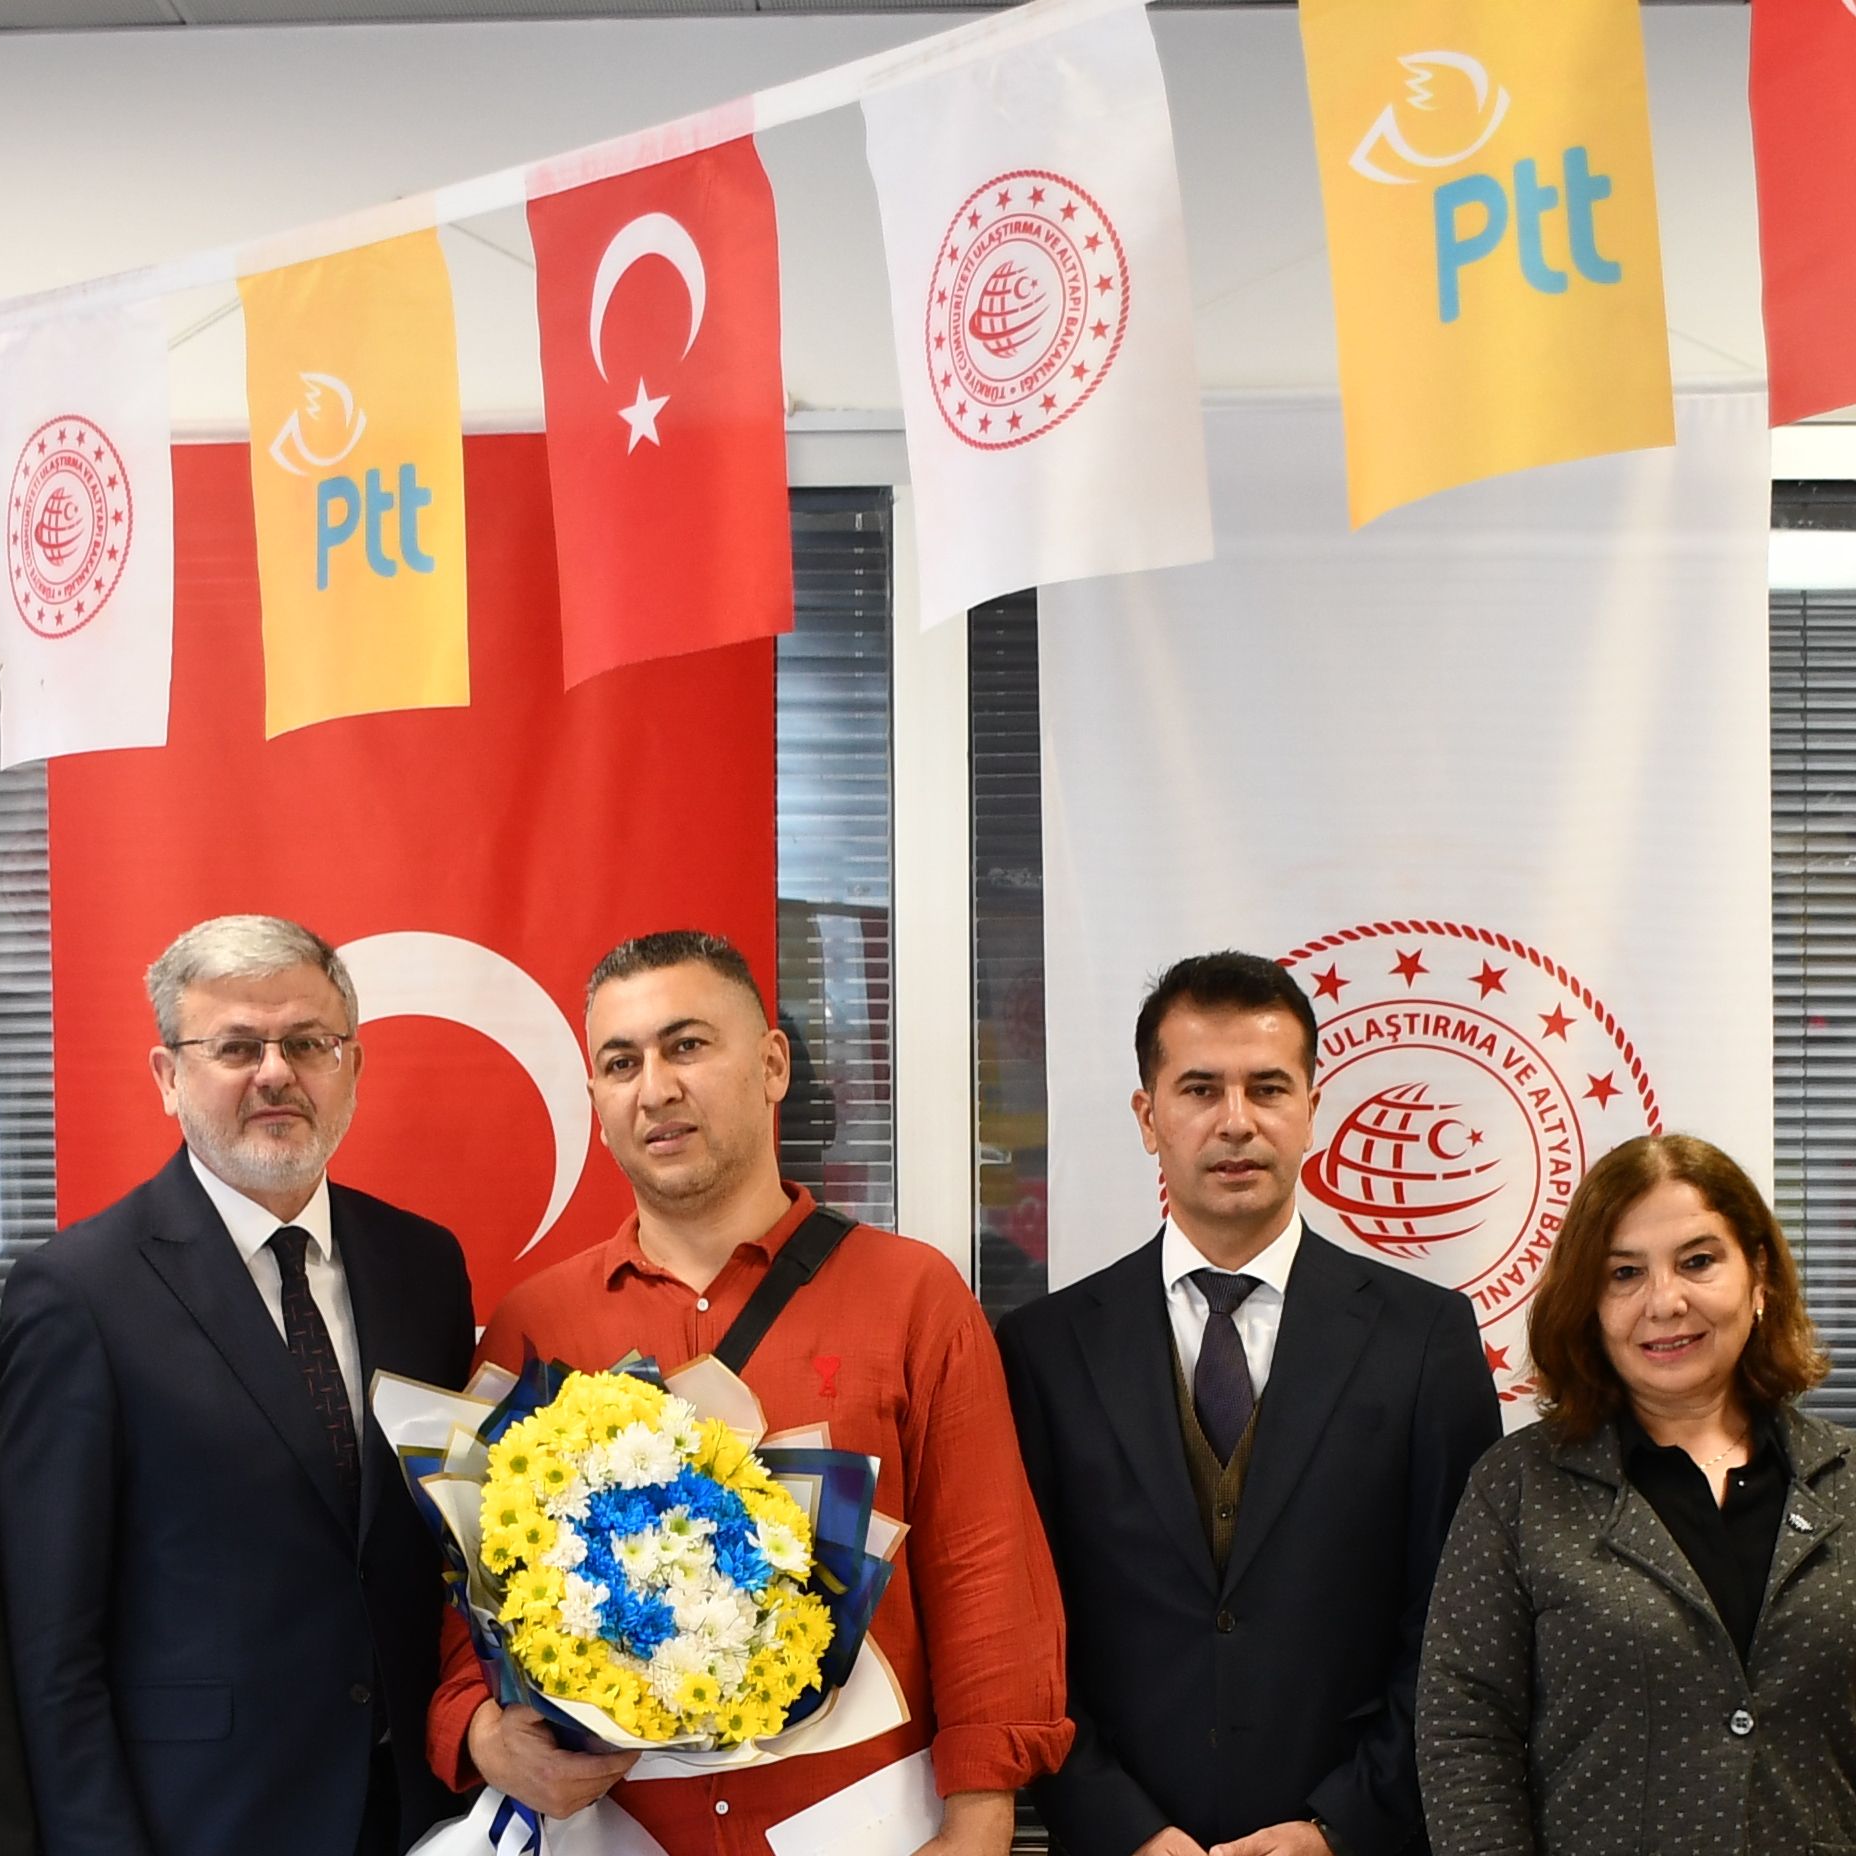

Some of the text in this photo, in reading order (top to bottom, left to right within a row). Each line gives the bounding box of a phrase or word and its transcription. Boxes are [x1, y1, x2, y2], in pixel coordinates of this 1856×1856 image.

[973, 221, 1042, 258] ULAŞTIRMA
[1044, 229, 1061, 250] VE
[1433, 145, 1623, 324] Ptt
[1056, 247, 1082, 311] ALTYAPI
[1020, 316, 1079, 392] BAKANLIĞI
[316, 462, 436, 592] Ptt
[1322, 1012, 1572, 1311] ULAŞTIRMA VE ALTYAPI BAKANL
